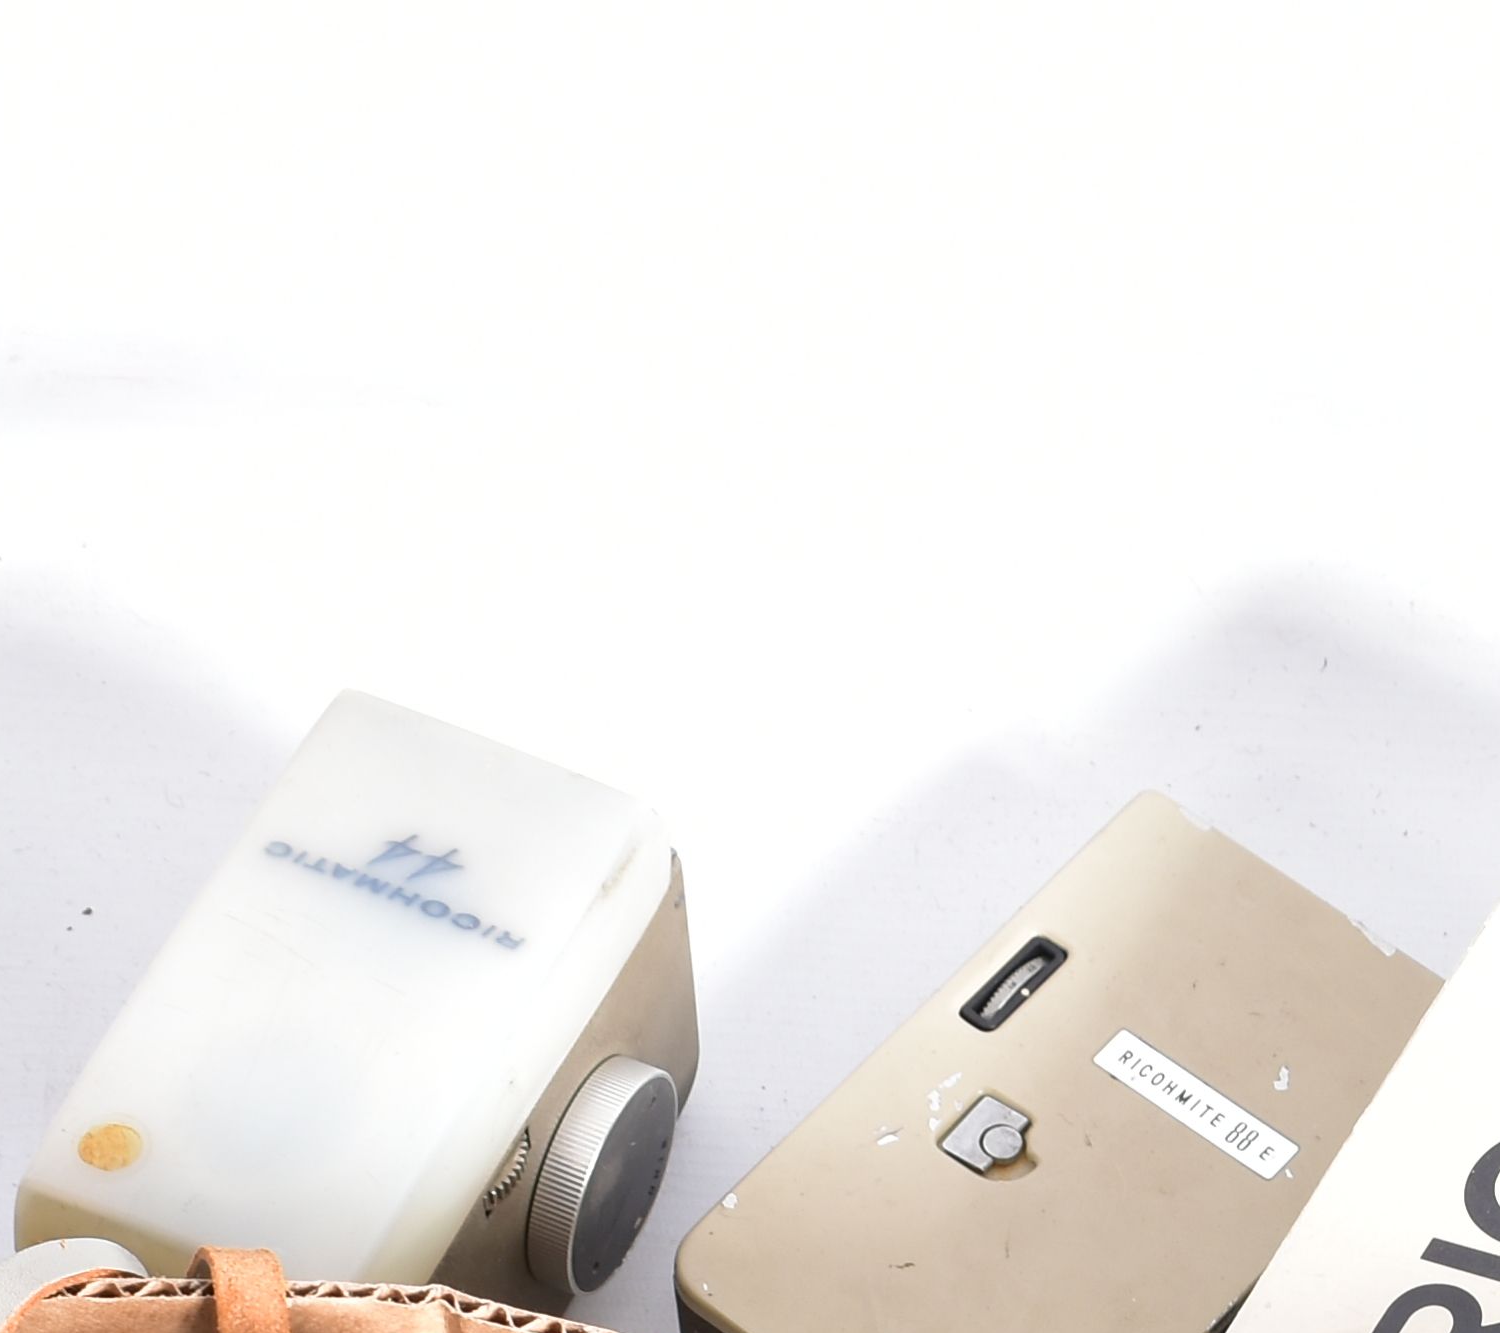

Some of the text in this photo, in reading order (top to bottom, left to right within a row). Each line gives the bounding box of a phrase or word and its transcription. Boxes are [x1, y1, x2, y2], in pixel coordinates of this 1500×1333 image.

[263, 840, 526, 950] RICOHMATIC
[366, 834, 465, 880] 44
[1117, 1050, 1275, 1162] RICOHMITE 88 E
